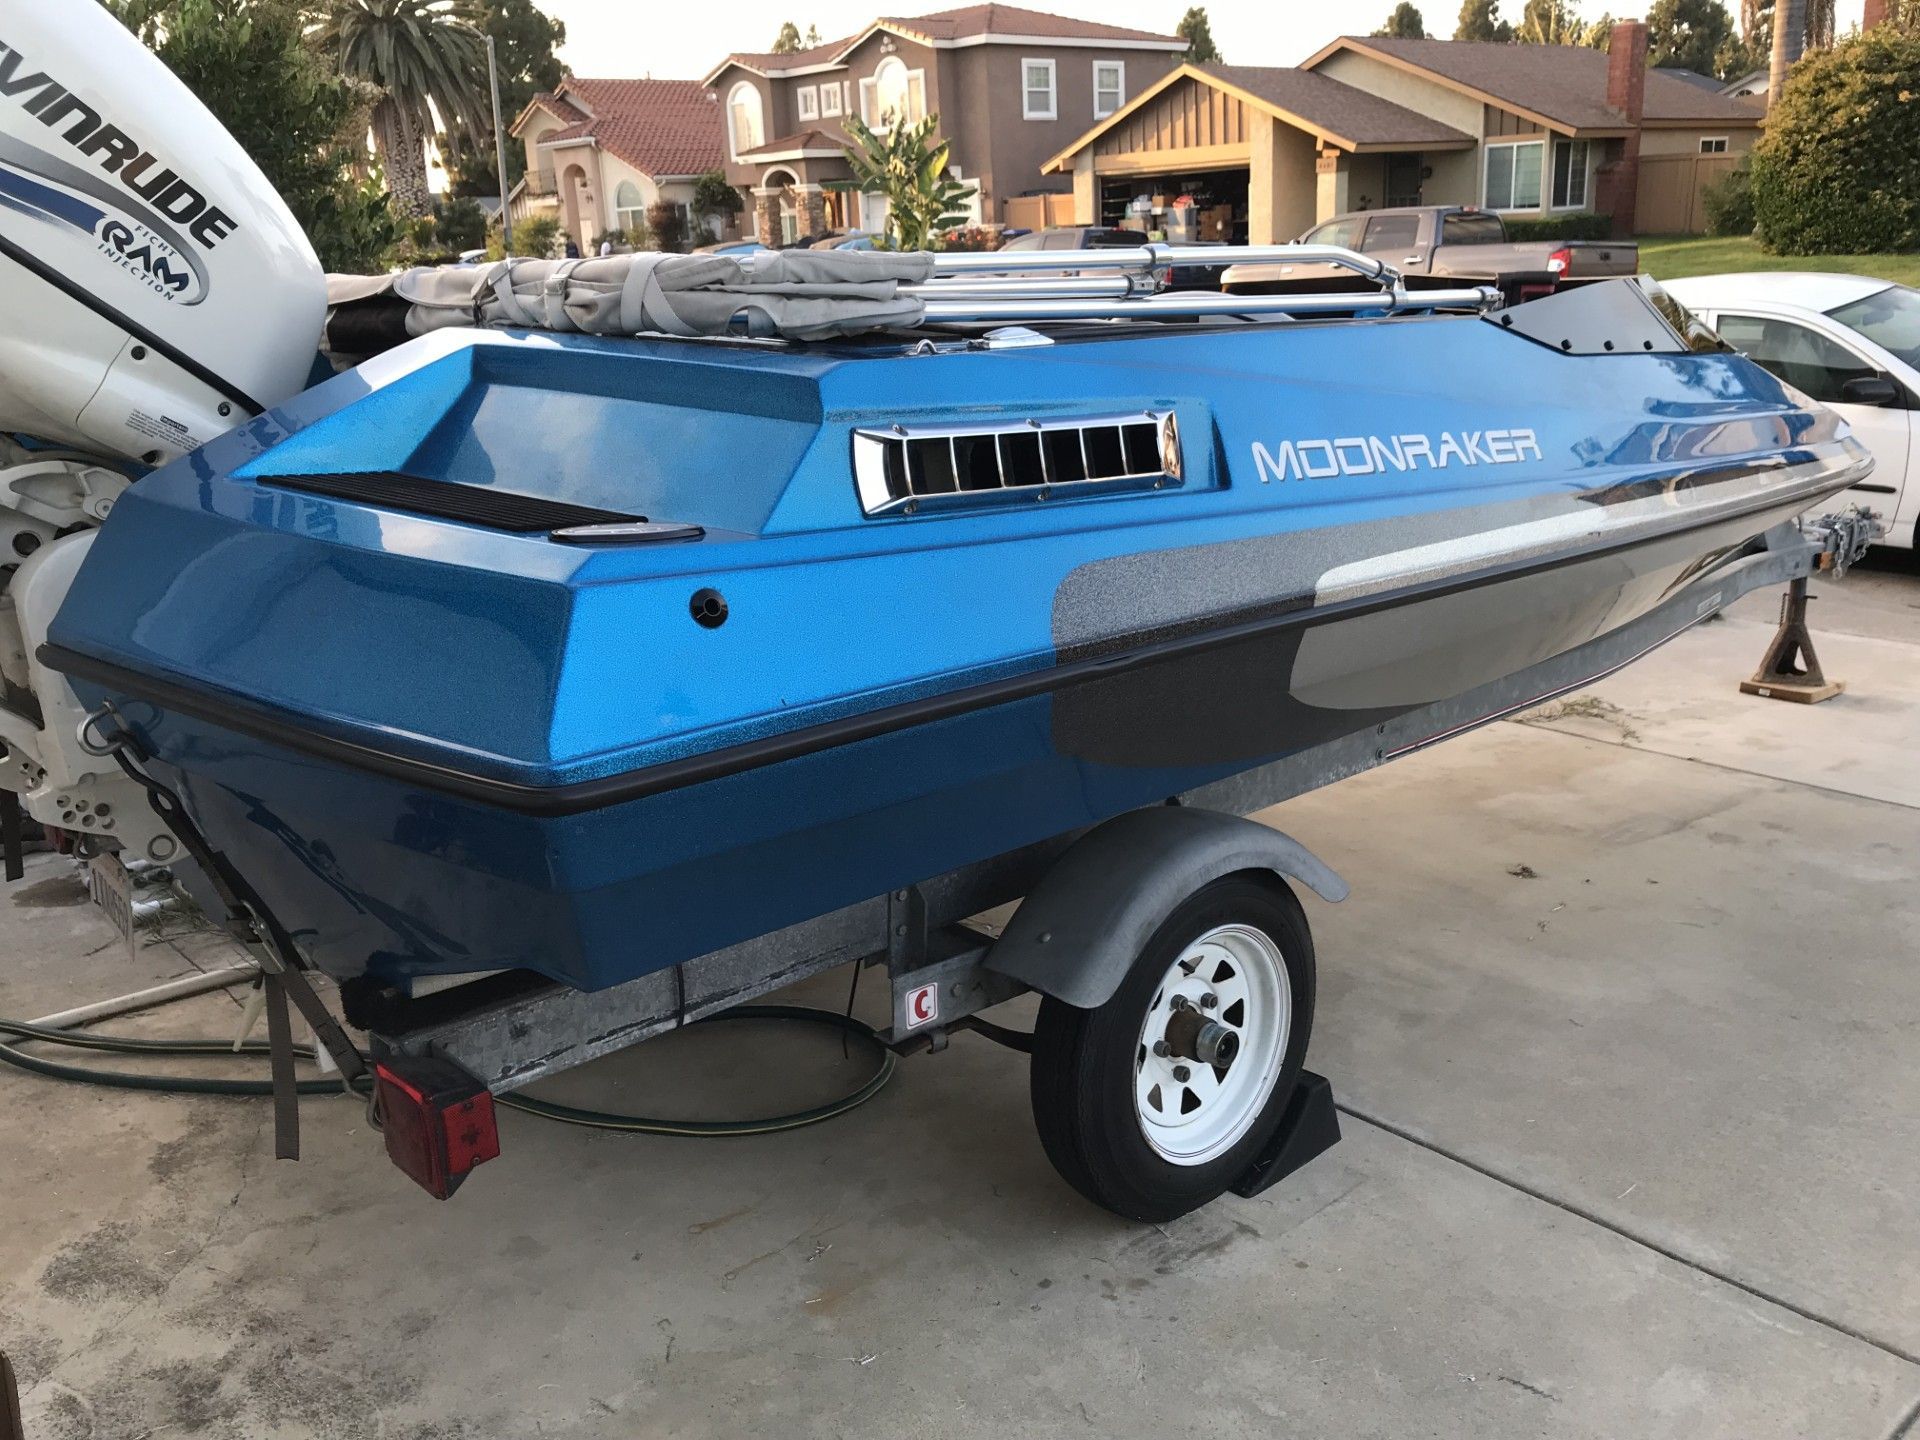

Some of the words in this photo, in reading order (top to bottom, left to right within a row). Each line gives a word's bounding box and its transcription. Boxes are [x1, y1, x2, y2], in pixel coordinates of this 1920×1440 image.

[0, 40, 238, 250] VINRUDE
[101, 220, 190, 292] RAM
[134, 224, 178, 257] FICHT
[97, 243, 175, 301] INJECTION
[1251, 428, 1542, 483] MOONRAKER
